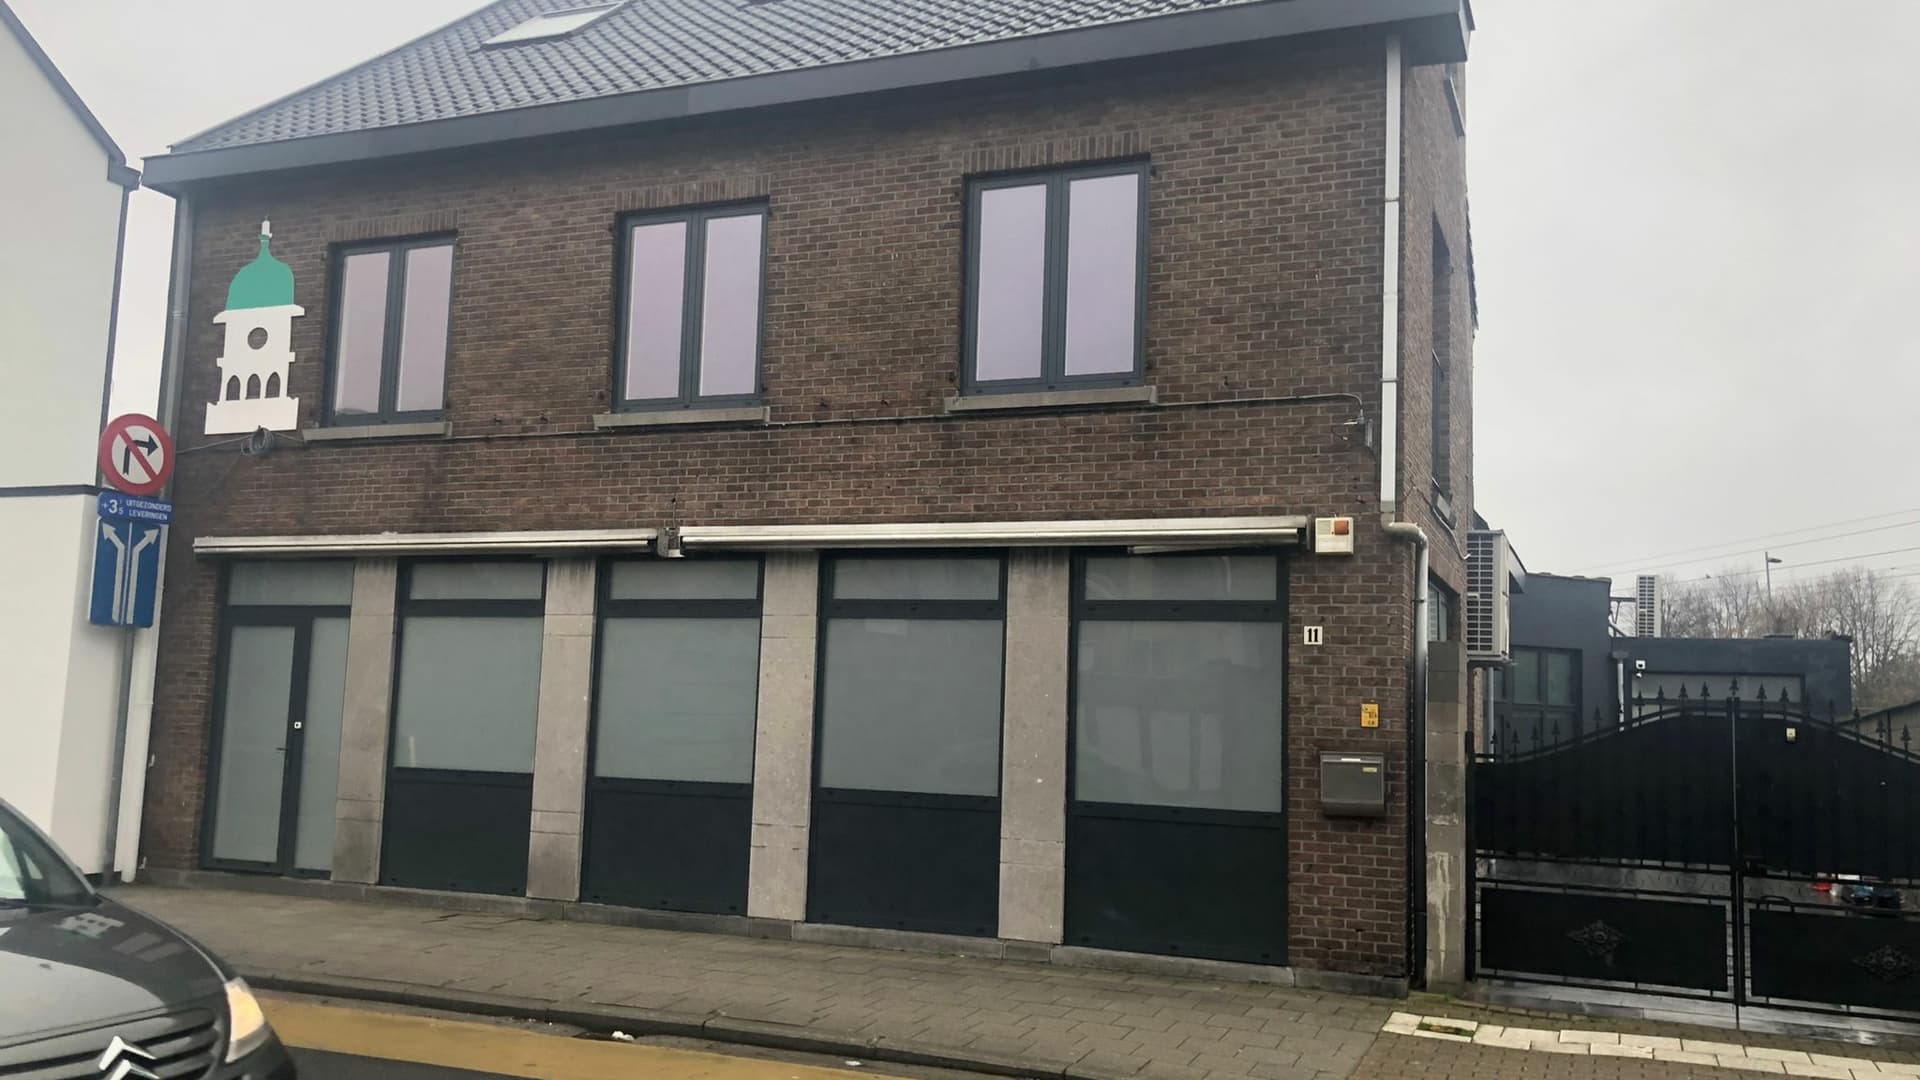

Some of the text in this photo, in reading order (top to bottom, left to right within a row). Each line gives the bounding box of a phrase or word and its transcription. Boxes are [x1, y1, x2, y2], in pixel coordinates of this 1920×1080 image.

[126, 499, 172, 512] UITGEZONDERD
[129, 509, 168, 520] LEVERINGEN
[1307, 628, 1318, 642] 11
